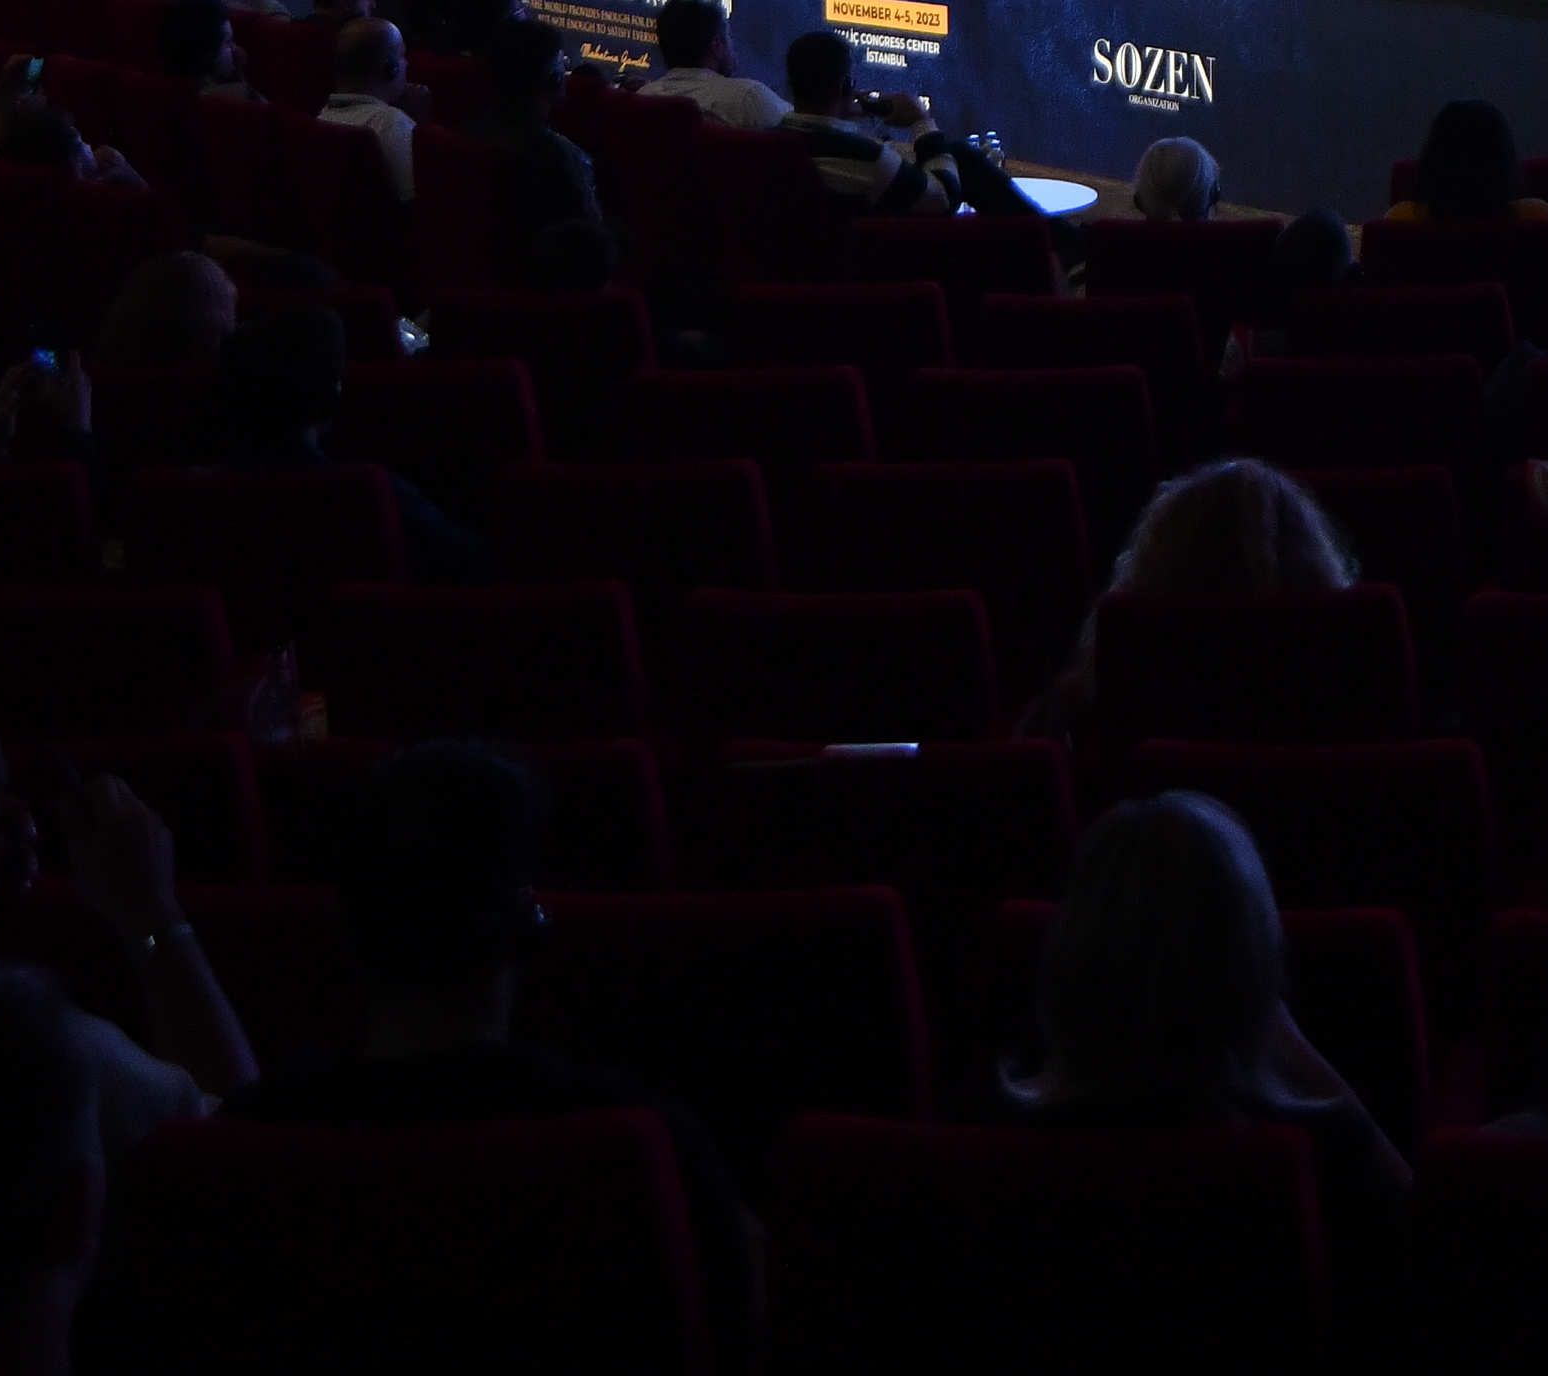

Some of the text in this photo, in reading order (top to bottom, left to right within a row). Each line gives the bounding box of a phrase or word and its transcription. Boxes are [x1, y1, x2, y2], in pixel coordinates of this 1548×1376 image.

[601, 10, 630, 25] ENOUGH
[833, 1, 940, 27] NOVEMBER 4-5, 2023
[566, 18, 595, 33] ENOUGH
[596, 23, 607, 34] TO
[860, 32, 905, 50] CONGRESS
[906, 39, 941, 55] CENTER
[1093, 37, 1215, 103] SOZEN
[1128, 93, 1180, 112] ORGANIZATION
